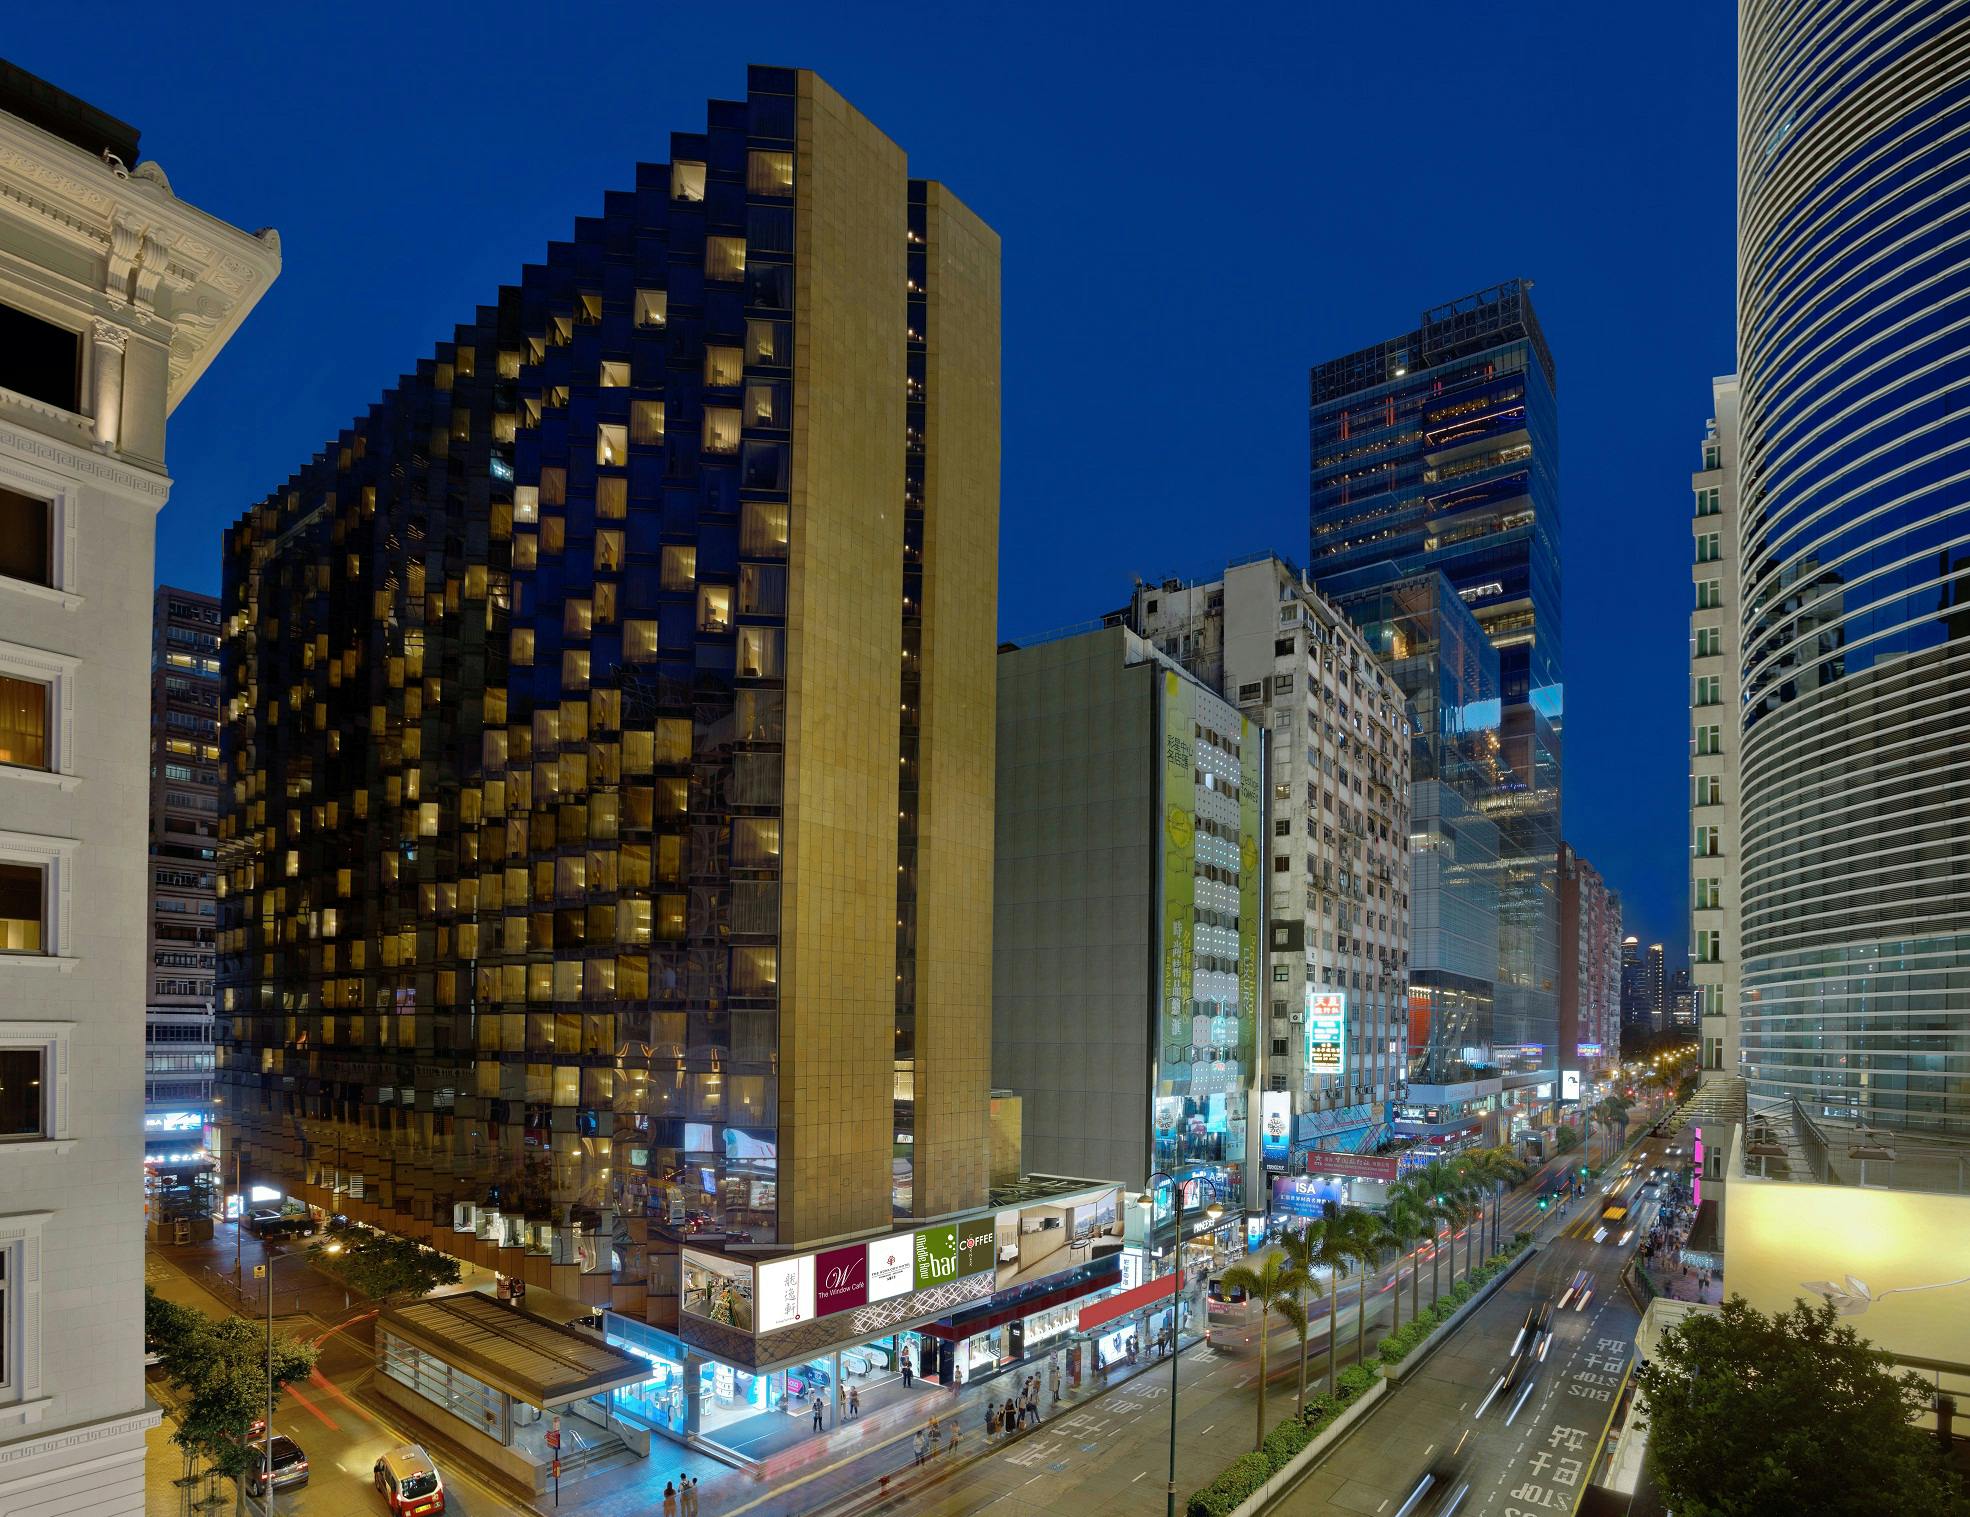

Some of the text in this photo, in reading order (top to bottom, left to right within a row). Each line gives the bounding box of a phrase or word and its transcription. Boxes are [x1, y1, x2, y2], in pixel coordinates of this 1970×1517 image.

[1295, 1182, 1316, 1194] ISA
[916, 1234, 927, 1262] Middle
[960, 1233, 993, 1251] COFFEE
[825, 1257, 864, 1289] W
[930, 1252, 956, 1278] bar
[818, 1281, 865, 1299] The Window Café
[1597, 1338, 1627, 1354] 站
[1584, 1352, 1625, 1374] 巴士
[1572, 1371, 1620, 1388] STOP
[1567, 1384, 1612, 1402] BUS
[1094, 1398, 1144, 1414] STOP
[1547, 1424, 1589, 1452] 站
[1528, 1451, 1583, 1487] 巴士
[1510, 1482, 1573, 1512] STOP
